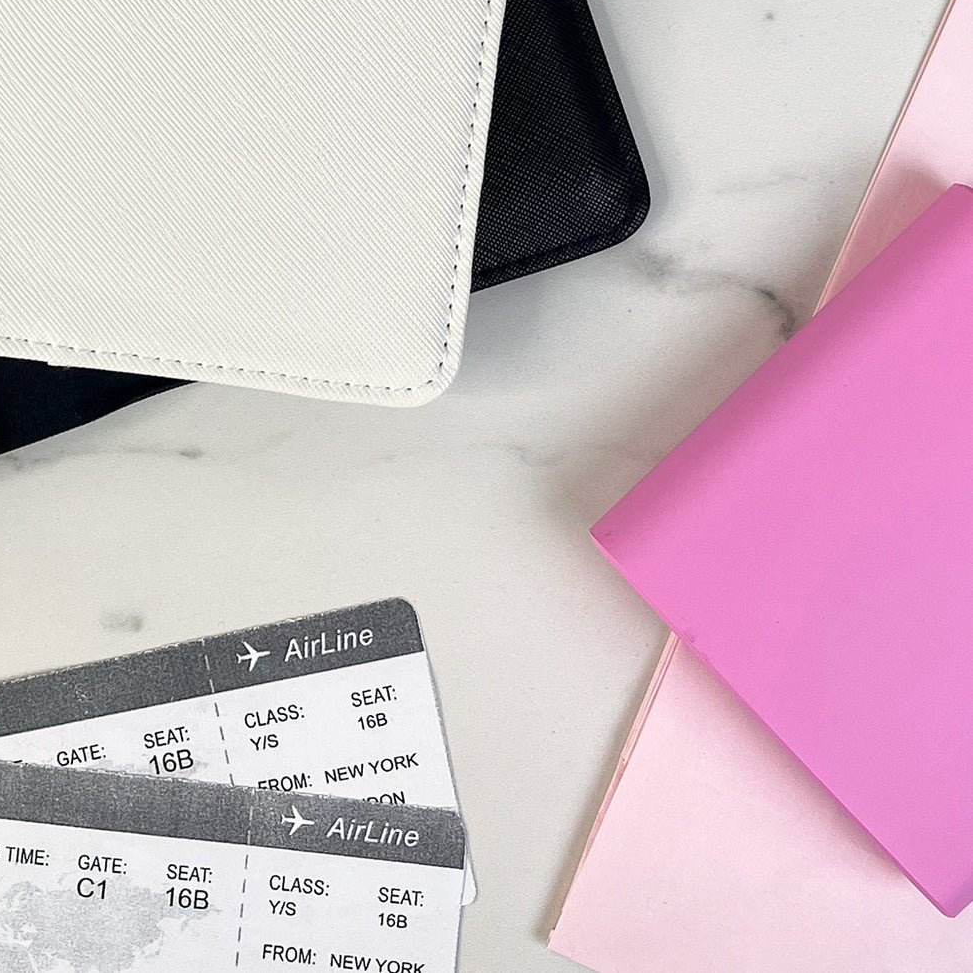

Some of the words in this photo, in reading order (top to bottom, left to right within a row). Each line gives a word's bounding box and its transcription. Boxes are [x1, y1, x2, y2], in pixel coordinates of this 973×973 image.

[284, 628, 374, 662] AirLine
[350, 684, 397, 708] SEAT:
[244, 704, 305, 729] CLASS:
[357, 712, 388, 731] 16B
[143, 726, 191, 749] SEAT:
[249, 733, 279, 751] Y/S
[56, 743, 106, 767] GATE:
[148, 748, 194, 775] 16B
[258, 773, 313, 793] FROM:
[324, 763, 365, 785] NEW
[367, 752, 420, 775] YORK
[326, 817, 420, 847] AirLine
[5, 845, 50, 867] TIME:
[78, 854, 127, 875] GATE:
[166, 863, 213, 884] SEAT:
[77, 877, 107, 900] C1
[269, 874, 329, 897] CLASS:
[378, 887, 424, 907] SEAT:
[165, 887, 209, 910] 16B
[269, 899, 297, 917] Y/S
[378, 913, 408, 929] 16B
[262, 943, 317, 965] FROM:
[329, 953, 372, 971] NEW
[375, 958, 426, 973] YORK
